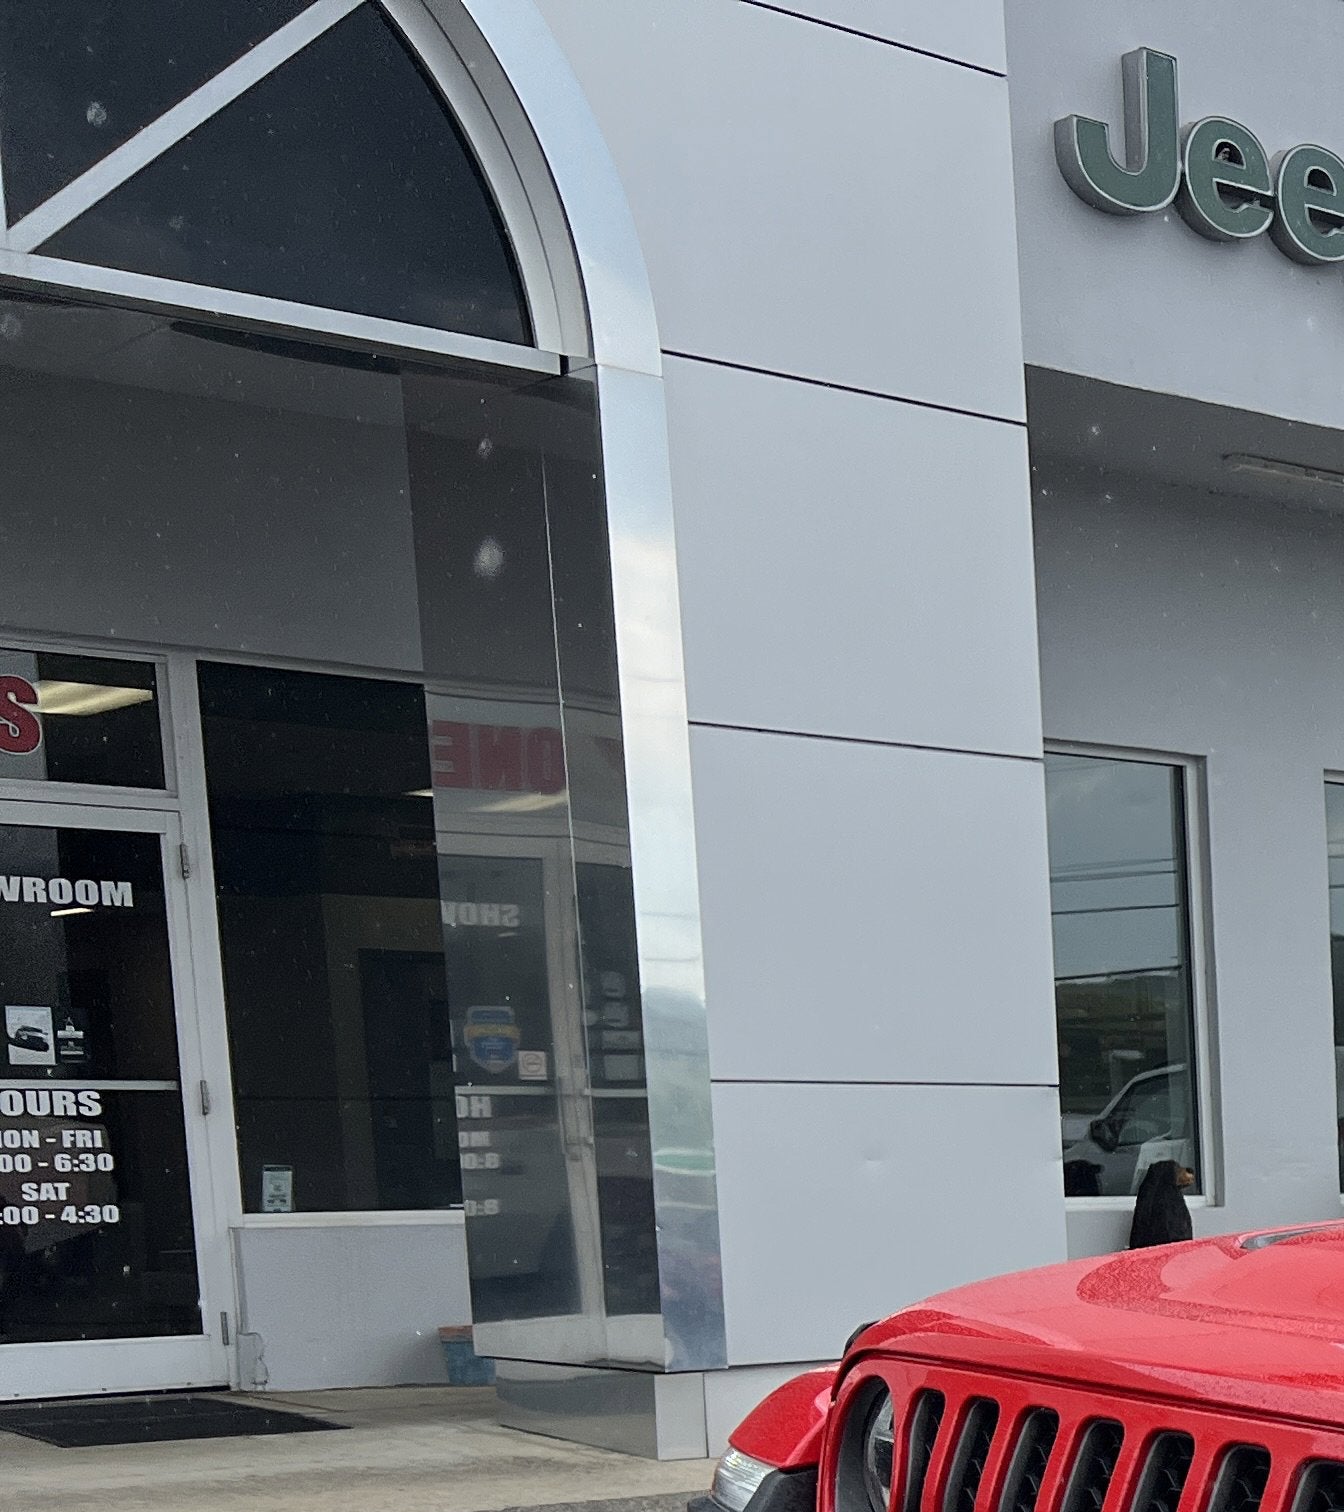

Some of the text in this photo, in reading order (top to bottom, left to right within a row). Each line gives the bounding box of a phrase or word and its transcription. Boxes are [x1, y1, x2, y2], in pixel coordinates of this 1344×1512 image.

[0, 1089, 102, 1117] OURS
[0, 1129, 40, 1148] ON
[61, 1129, 103, 1148] FRI
[54, 1152, 114, 1172] 6:30
[21, 1182, 71, 1201] SAT
[60, 1204, 120, 1224] 4:30
